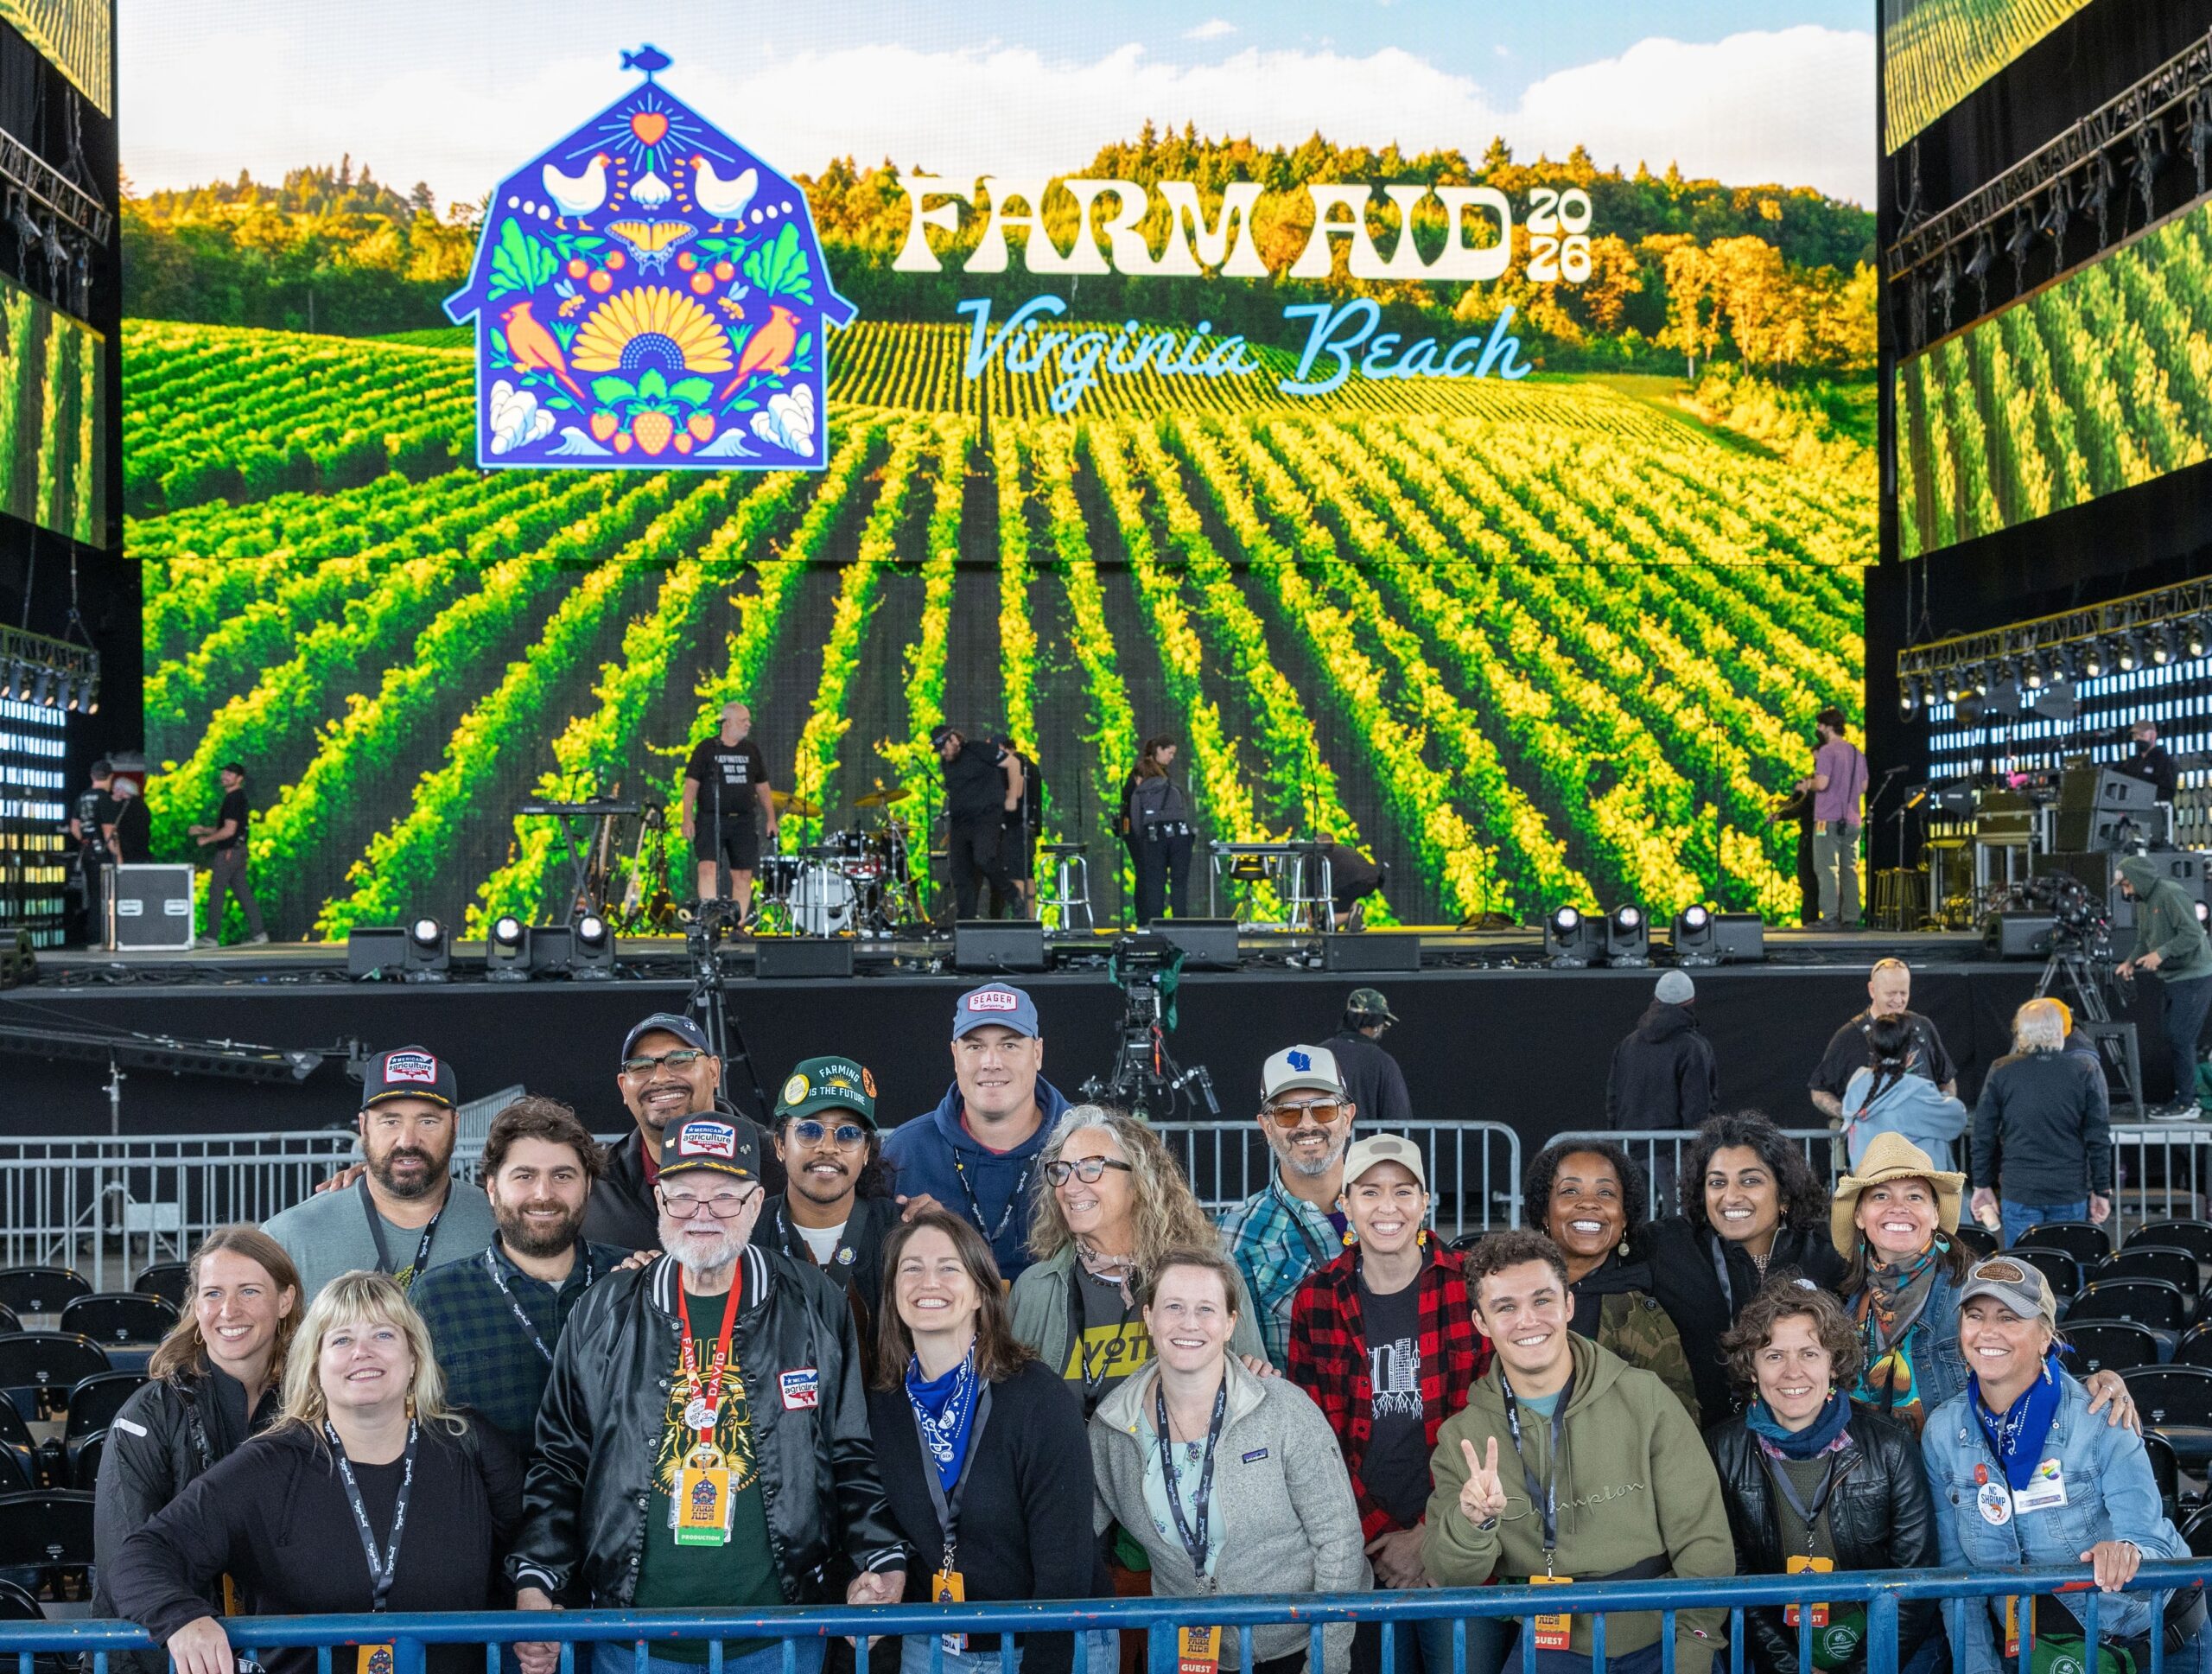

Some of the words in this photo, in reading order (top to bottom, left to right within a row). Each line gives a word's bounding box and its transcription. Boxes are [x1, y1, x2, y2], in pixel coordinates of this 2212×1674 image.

[1526, 187, 1592, 234] 20
[892, 175, 1269, 277] FARM
[1288, 183, 1512, 281] AID
[1526, 234, 1592, 283] 26
[956, 294, 1259, 413] Virginia
[1277, 297, 1533, 396] Beach
[715, 754, 750, 764] EFINITELY
[723, 765, 736, 773] NOT
[736, 765, 747, 773] ON
[973, 994, 1012, 1005] SEAGER
[388, 1061, 432, 1072] agriculture
[818, 1064, 861, 1083] FARMING
[809, 1087, 817, 1098] IS
[819, 1086, 837, 1096] THE
[839, 1087, 866, 1106] FUTURE
[683, 1133, 732, 1144] agriculture
[709, 1352, 725, 1397] DAVID
[1988, 1486, 1997, 1496] NC
[1500, 1482, 1645, 1521] Chmpion
[1980, 1493, 2006, 1506] SHRIMP
[1793, 1614, 1822, 1623] GST
[1180, 1664, 1211, 1674] GUEST
